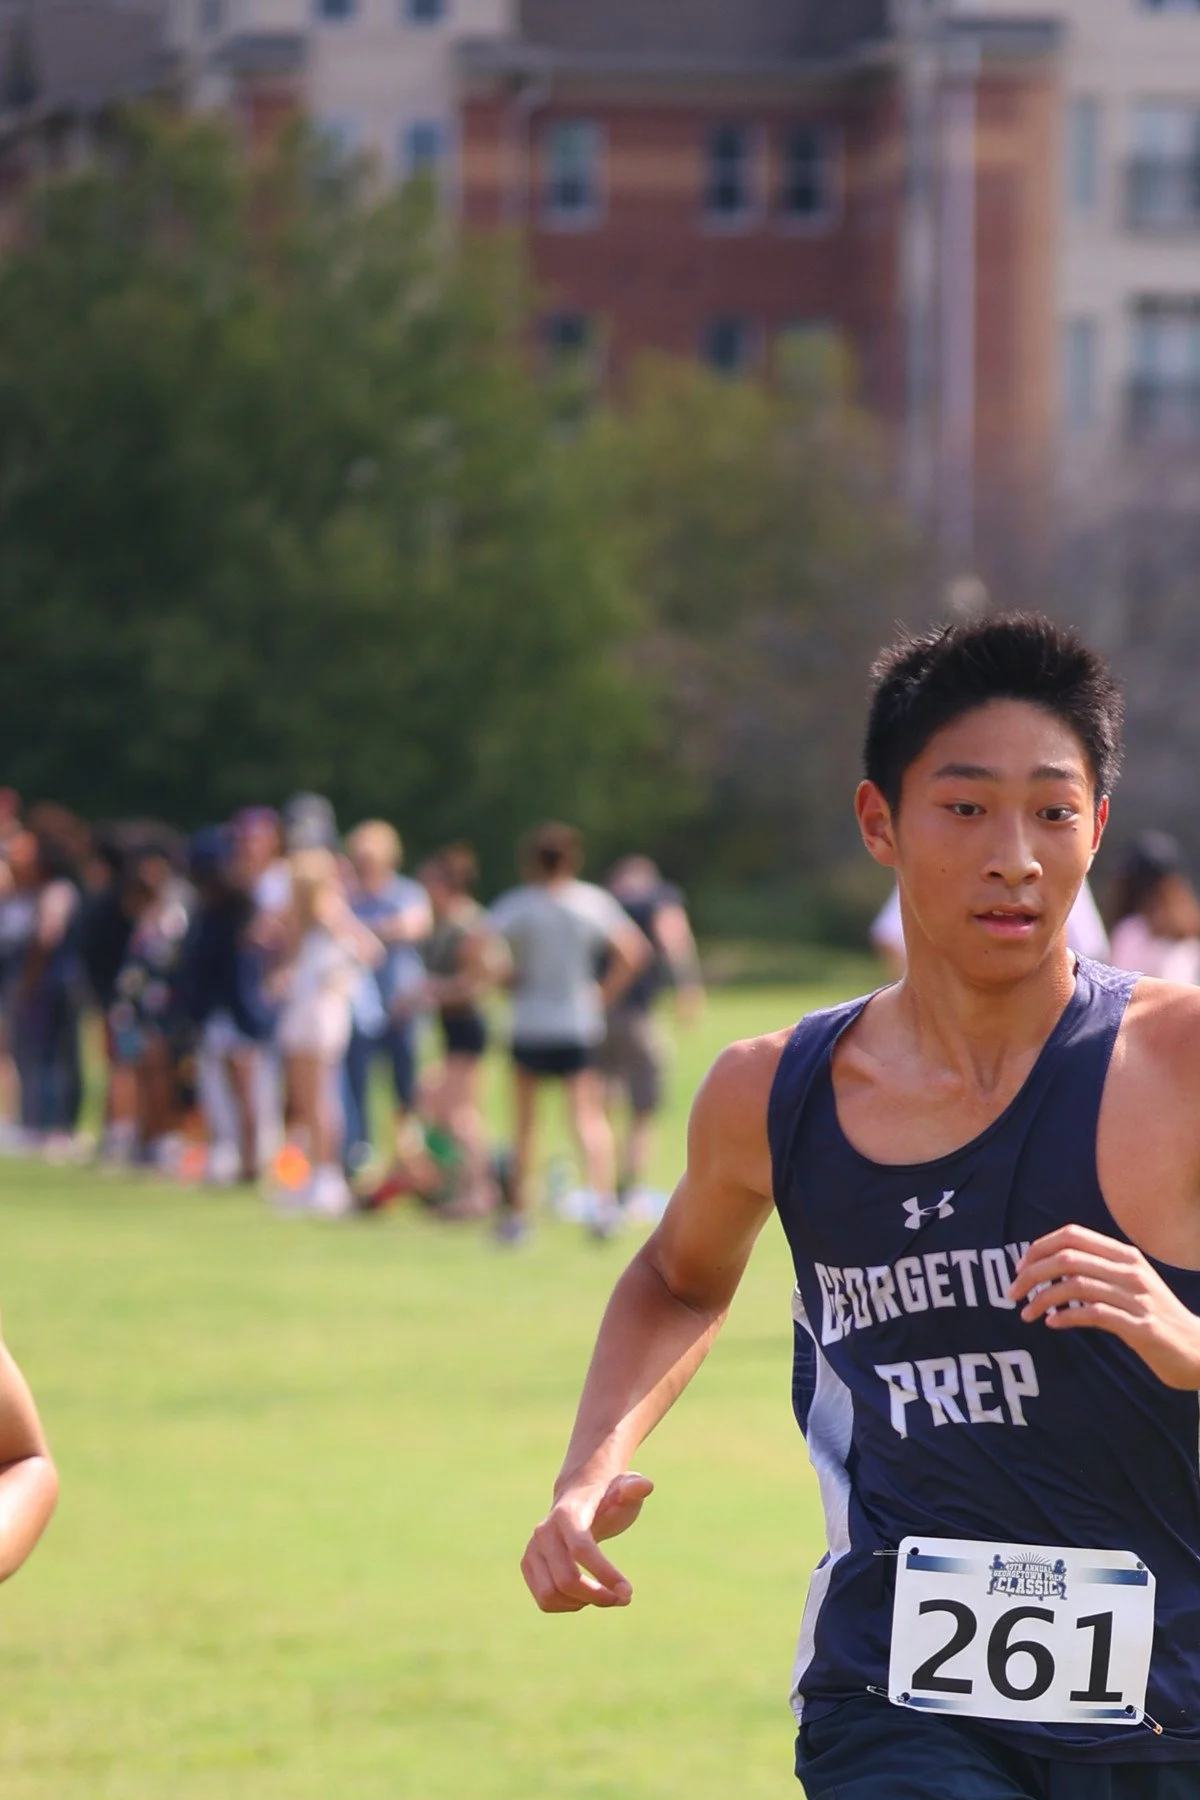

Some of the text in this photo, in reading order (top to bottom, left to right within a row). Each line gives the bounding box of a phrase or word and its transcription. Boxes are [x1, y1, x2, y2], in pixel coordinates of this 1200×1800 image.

[814, 1240, 1086, 1346] GEORGETO
[874, 1348, 1040, 1440] PREP
[993, 1570, 1064, 1582] GEORGETOWN PREP
[997, 1577, 1059, 1595] CLASSIC
[1025, 1564, 1053, 1573] ANNUAL
[911, 1598, 1124, 1703] 261
